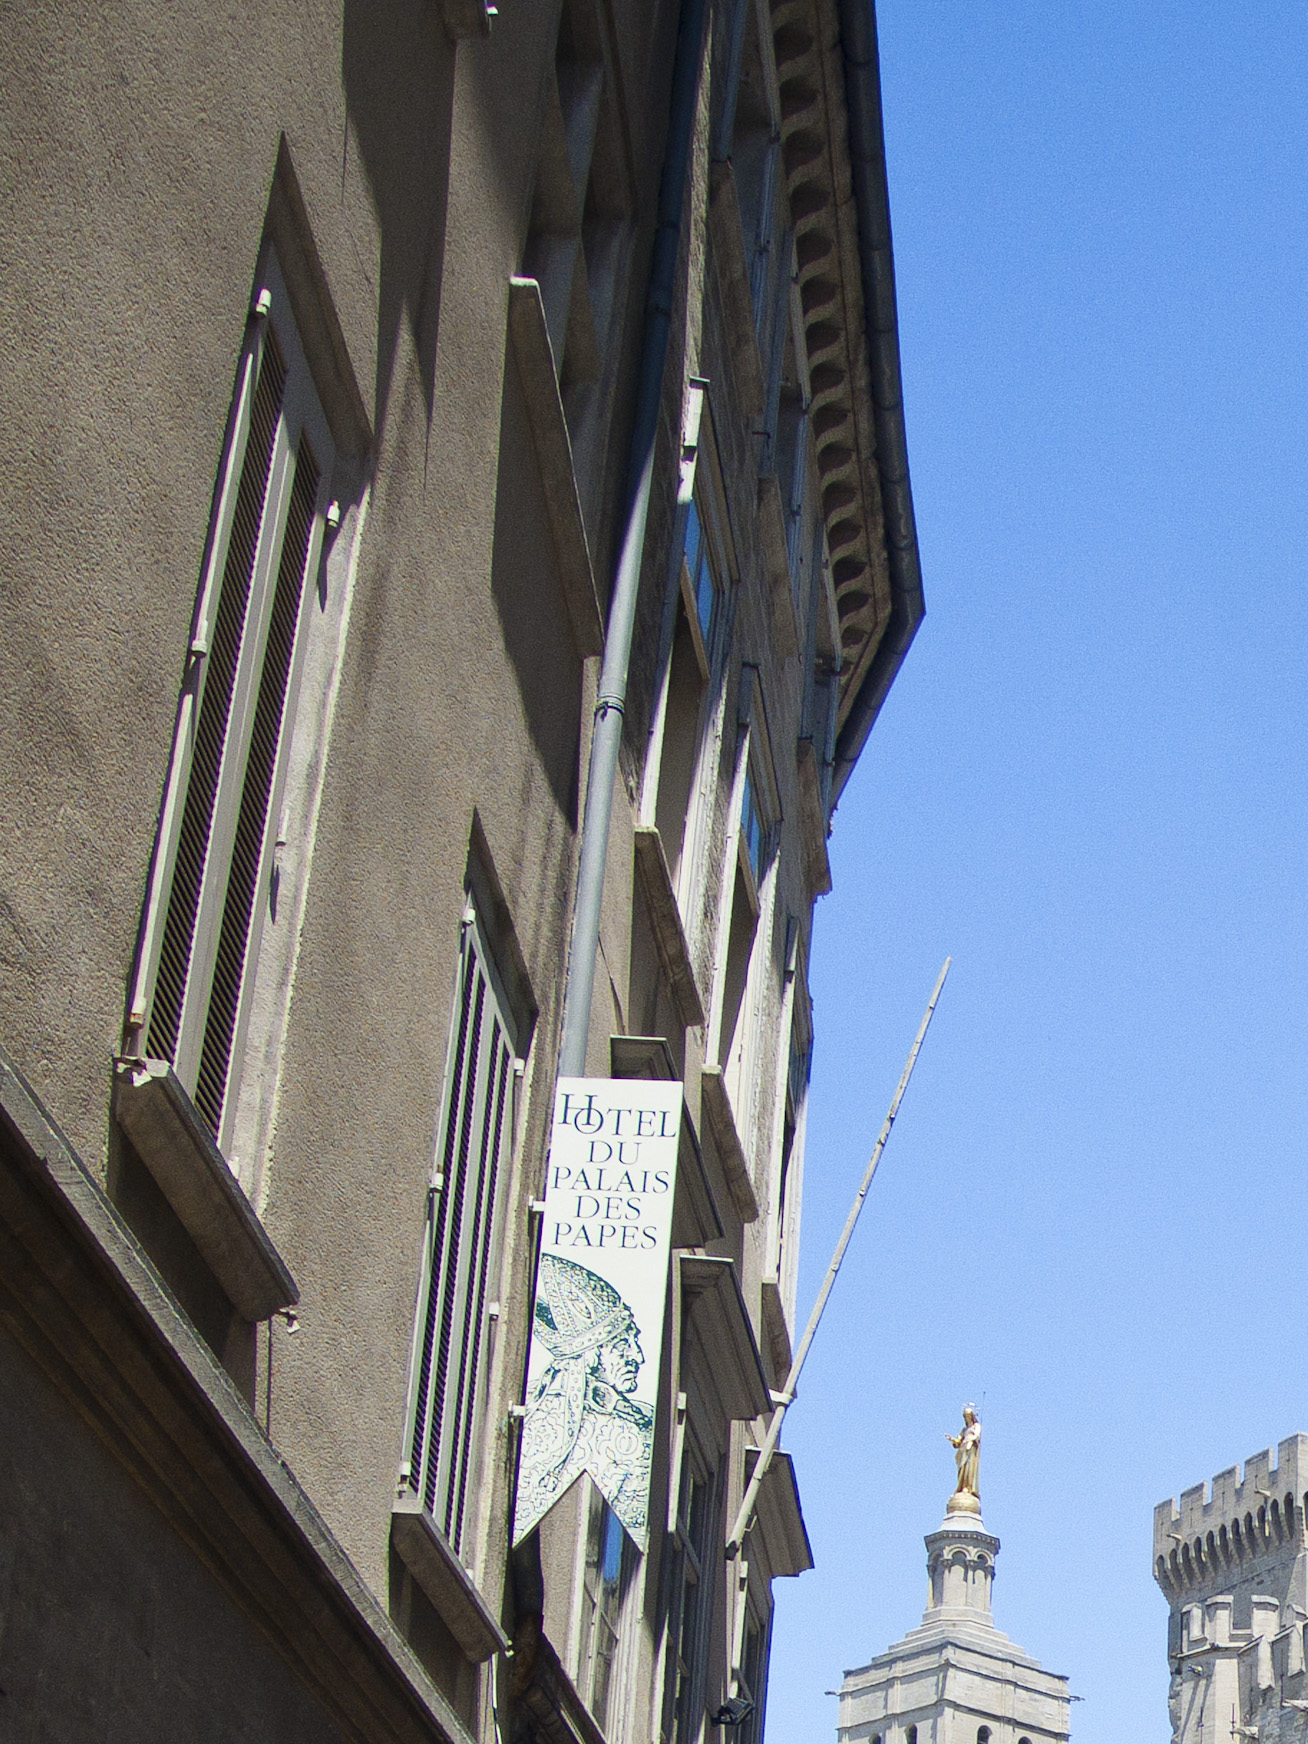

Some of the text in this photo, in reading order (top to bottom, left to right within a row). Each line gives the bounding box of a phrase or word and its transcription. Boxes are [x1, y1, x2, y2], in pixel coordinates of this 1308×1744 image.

[586, 1140, 642, 1165] DU
[551, 1166, 670, 1193] PALAIS
[574, 1195, 641, 1220] DES
[551, 1222, 658, 1249] PAPES
